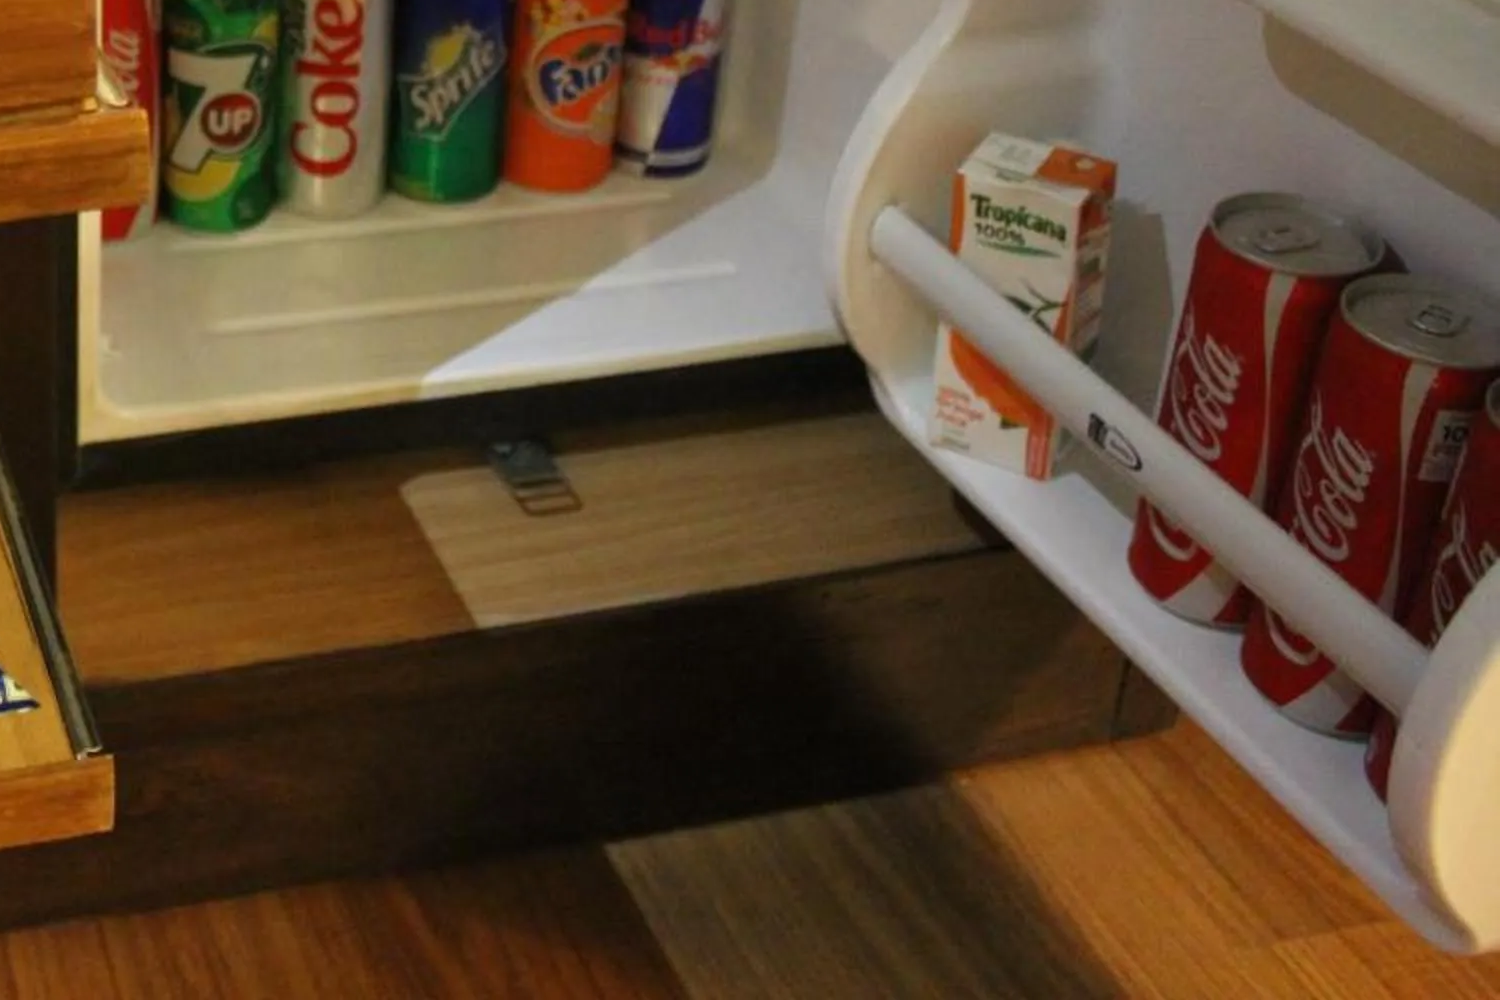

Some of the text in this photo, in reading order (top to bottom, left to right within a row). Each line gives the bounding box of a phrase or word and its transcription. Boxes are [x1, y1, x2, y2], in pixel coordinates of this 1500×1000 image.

[409, 34, 497, 131] Sprite
[969, 193, 1068, 244] Tropicana
[973, 222, 1027, 247] 100%
[1293, 388, 1377, 563] Cola
